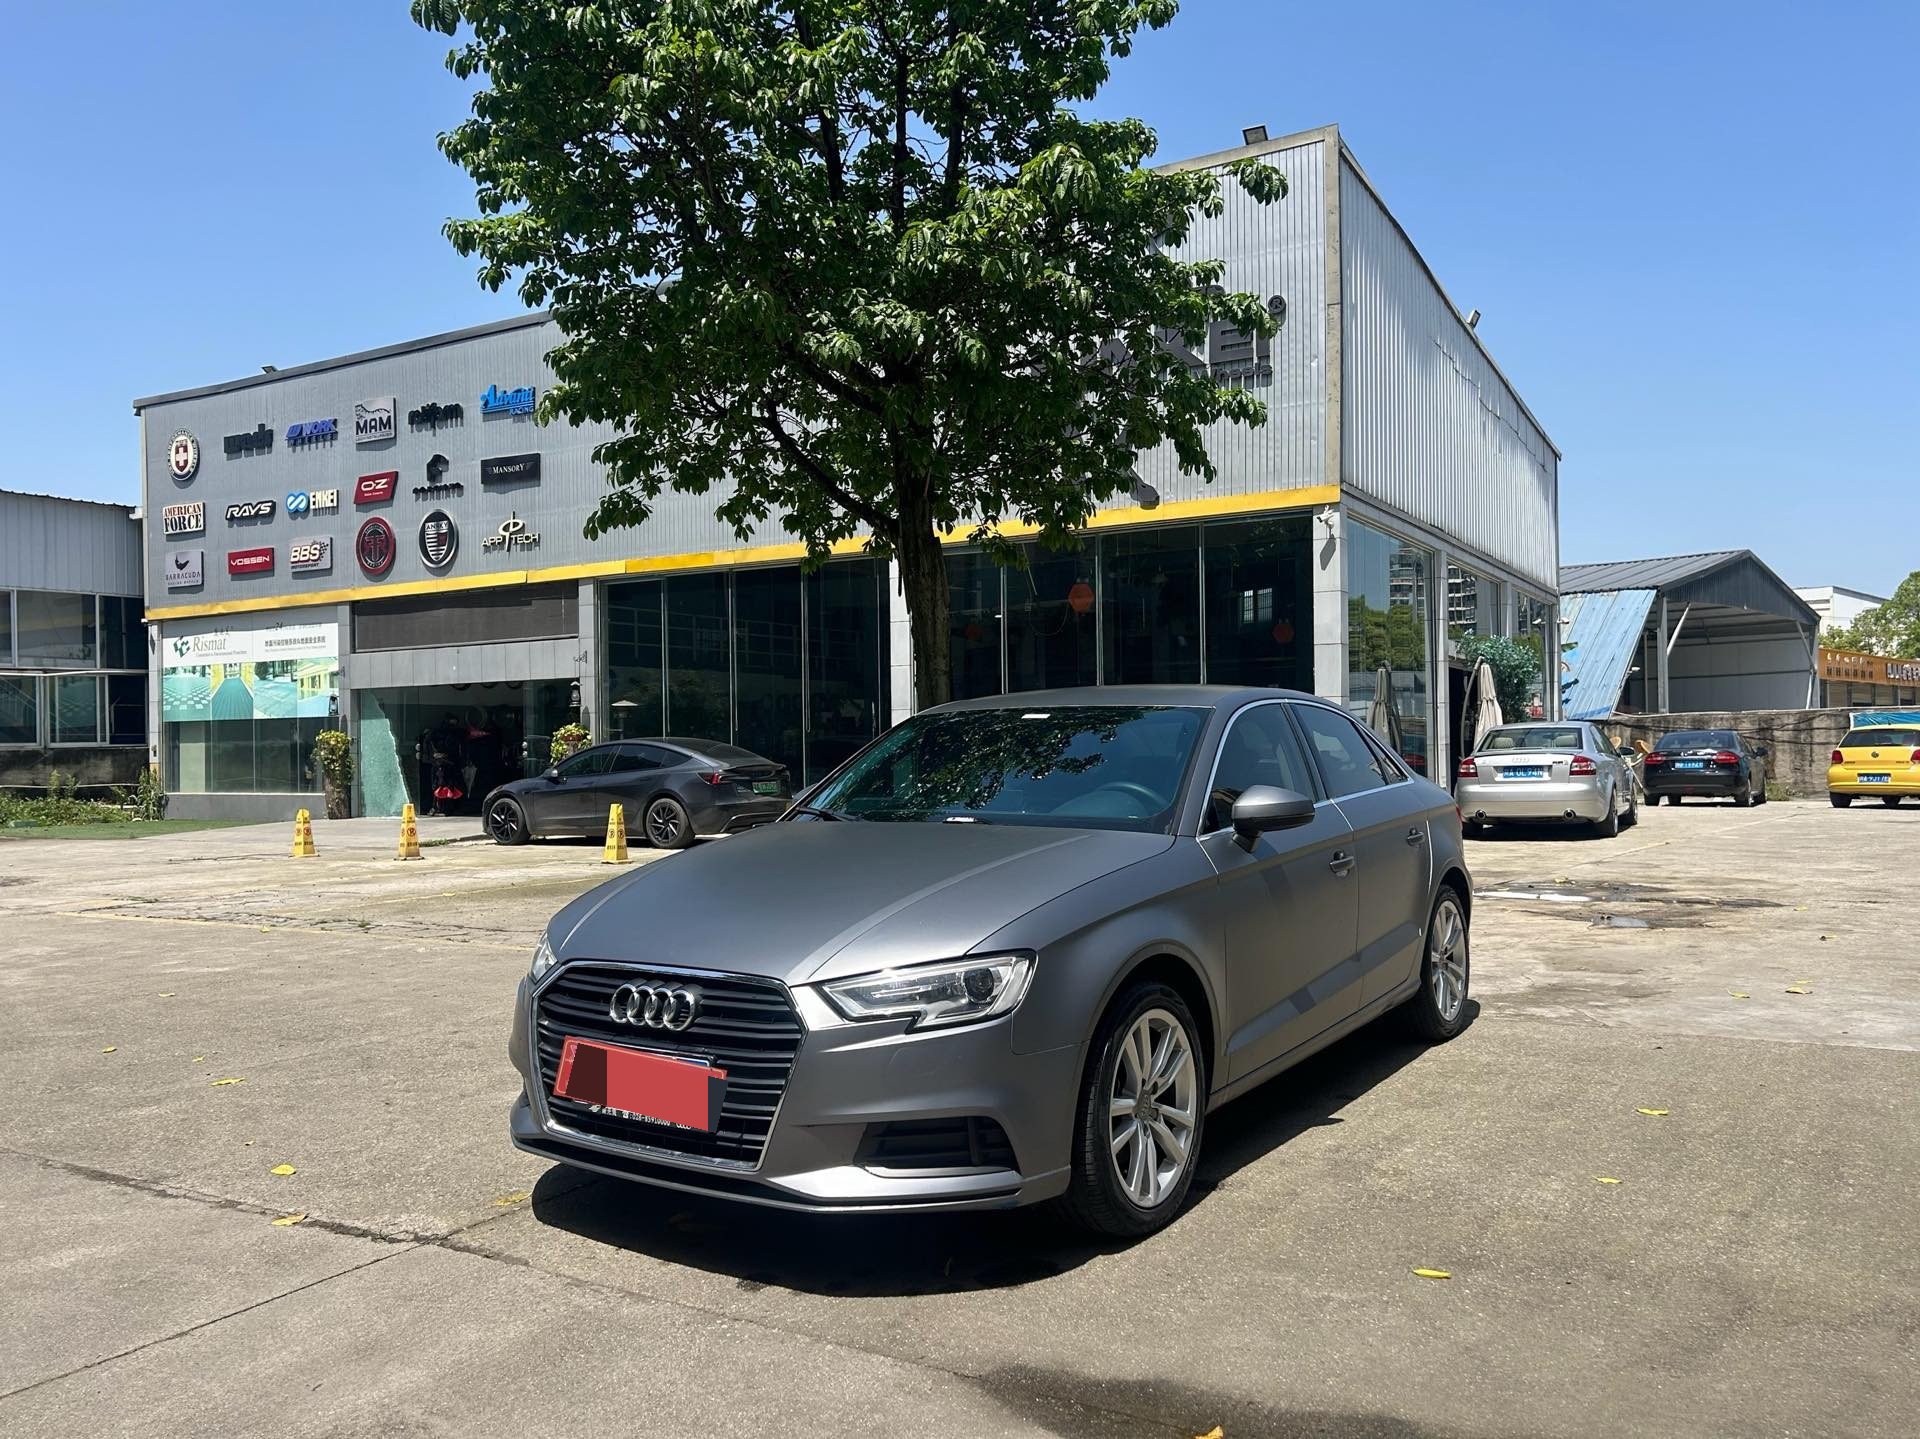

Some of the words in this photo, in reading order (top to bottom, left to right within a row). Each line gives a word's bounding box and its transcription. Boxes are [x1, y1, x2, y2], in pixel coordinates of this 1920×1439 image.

[509, 405, 535, 415] RACING
[303, 418, 335, 436] WORK
[356, 415, 392, 435] MAM
[492, 463, 525, 474] MANSORY
[310, 489, 338, 510] ENKEI
[164, 503, 202, 517] AMERICAN
[226, 502, 272, 518] RAYS
[164, 514, 202, 532] FORCE
[230, 555, 270, 566] VOSSEN
[290, 544, 321, 563] BBS
[165, 571, 201, 581] BARRACUDA
[192, 635, 227, 652] Rismat
